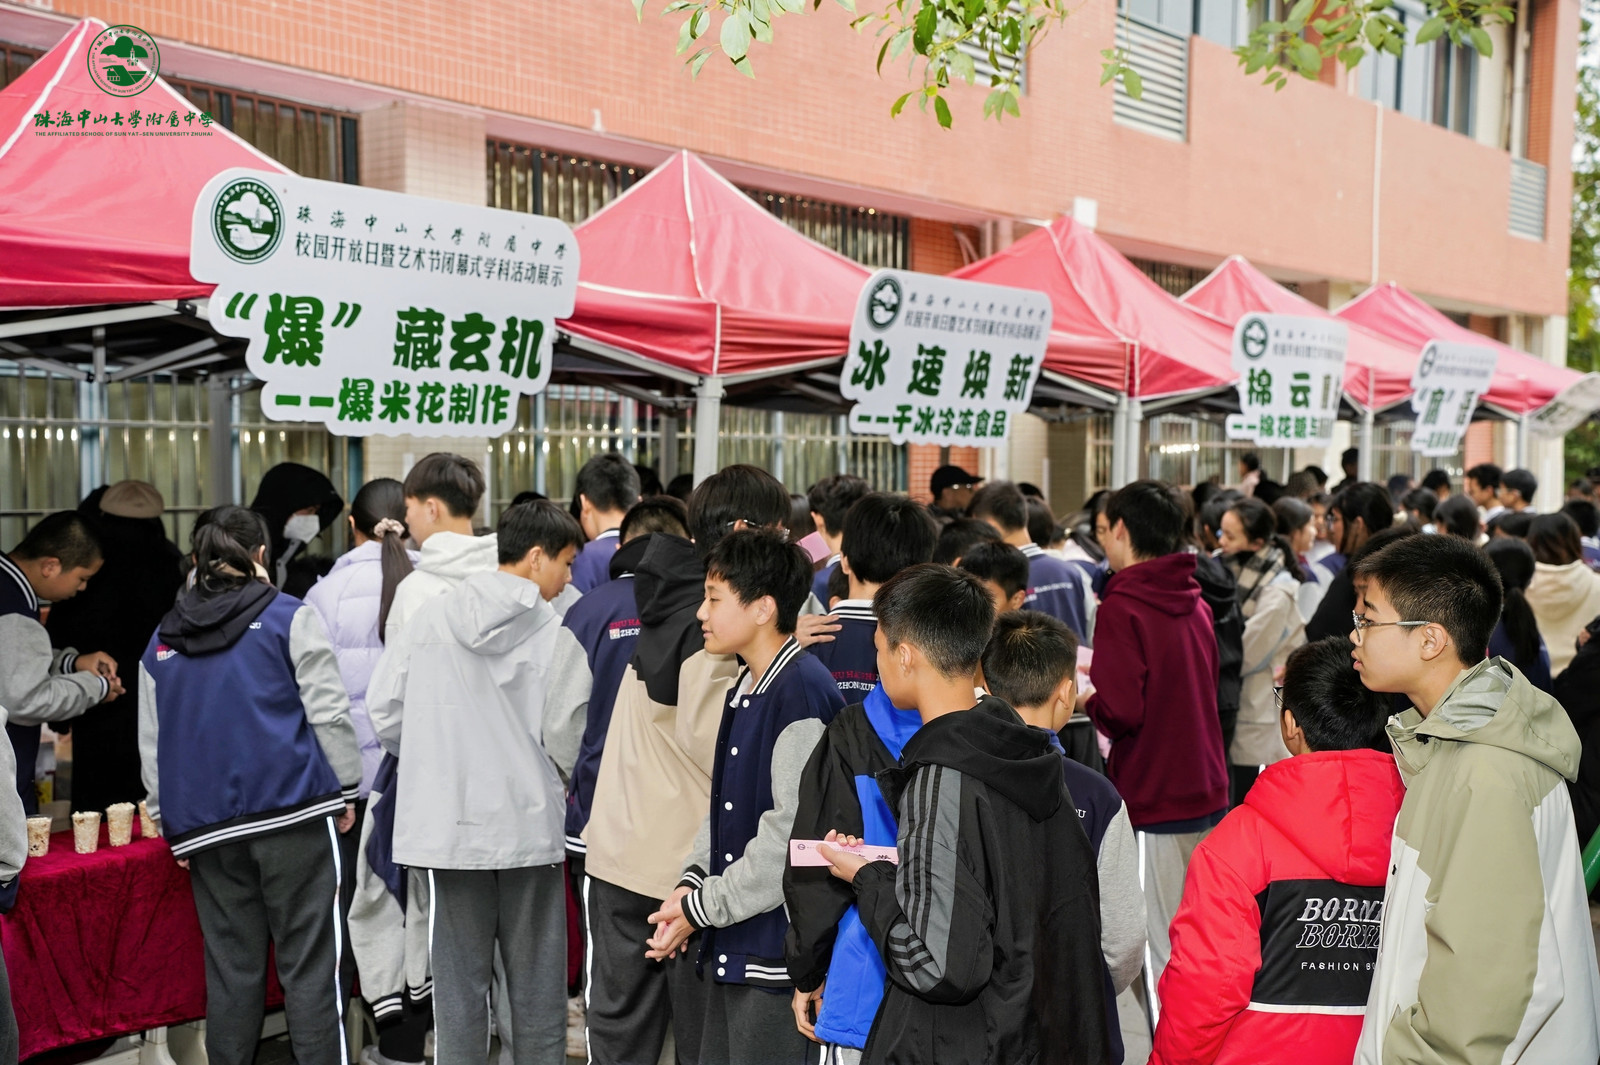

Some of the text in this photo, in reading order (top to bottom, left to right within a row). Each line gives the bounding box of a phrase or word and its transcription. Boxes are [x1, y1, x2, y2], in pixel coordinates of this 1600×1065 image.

[295, 231, 564, 288] 校园开放日暨艺术节闭幕式学科活动展示
[392, 306, 545, 380] 藏玄机
[851, 339, 1035, 401] 冰速焕新
[1301, 962, 1359, 971] FASHION
